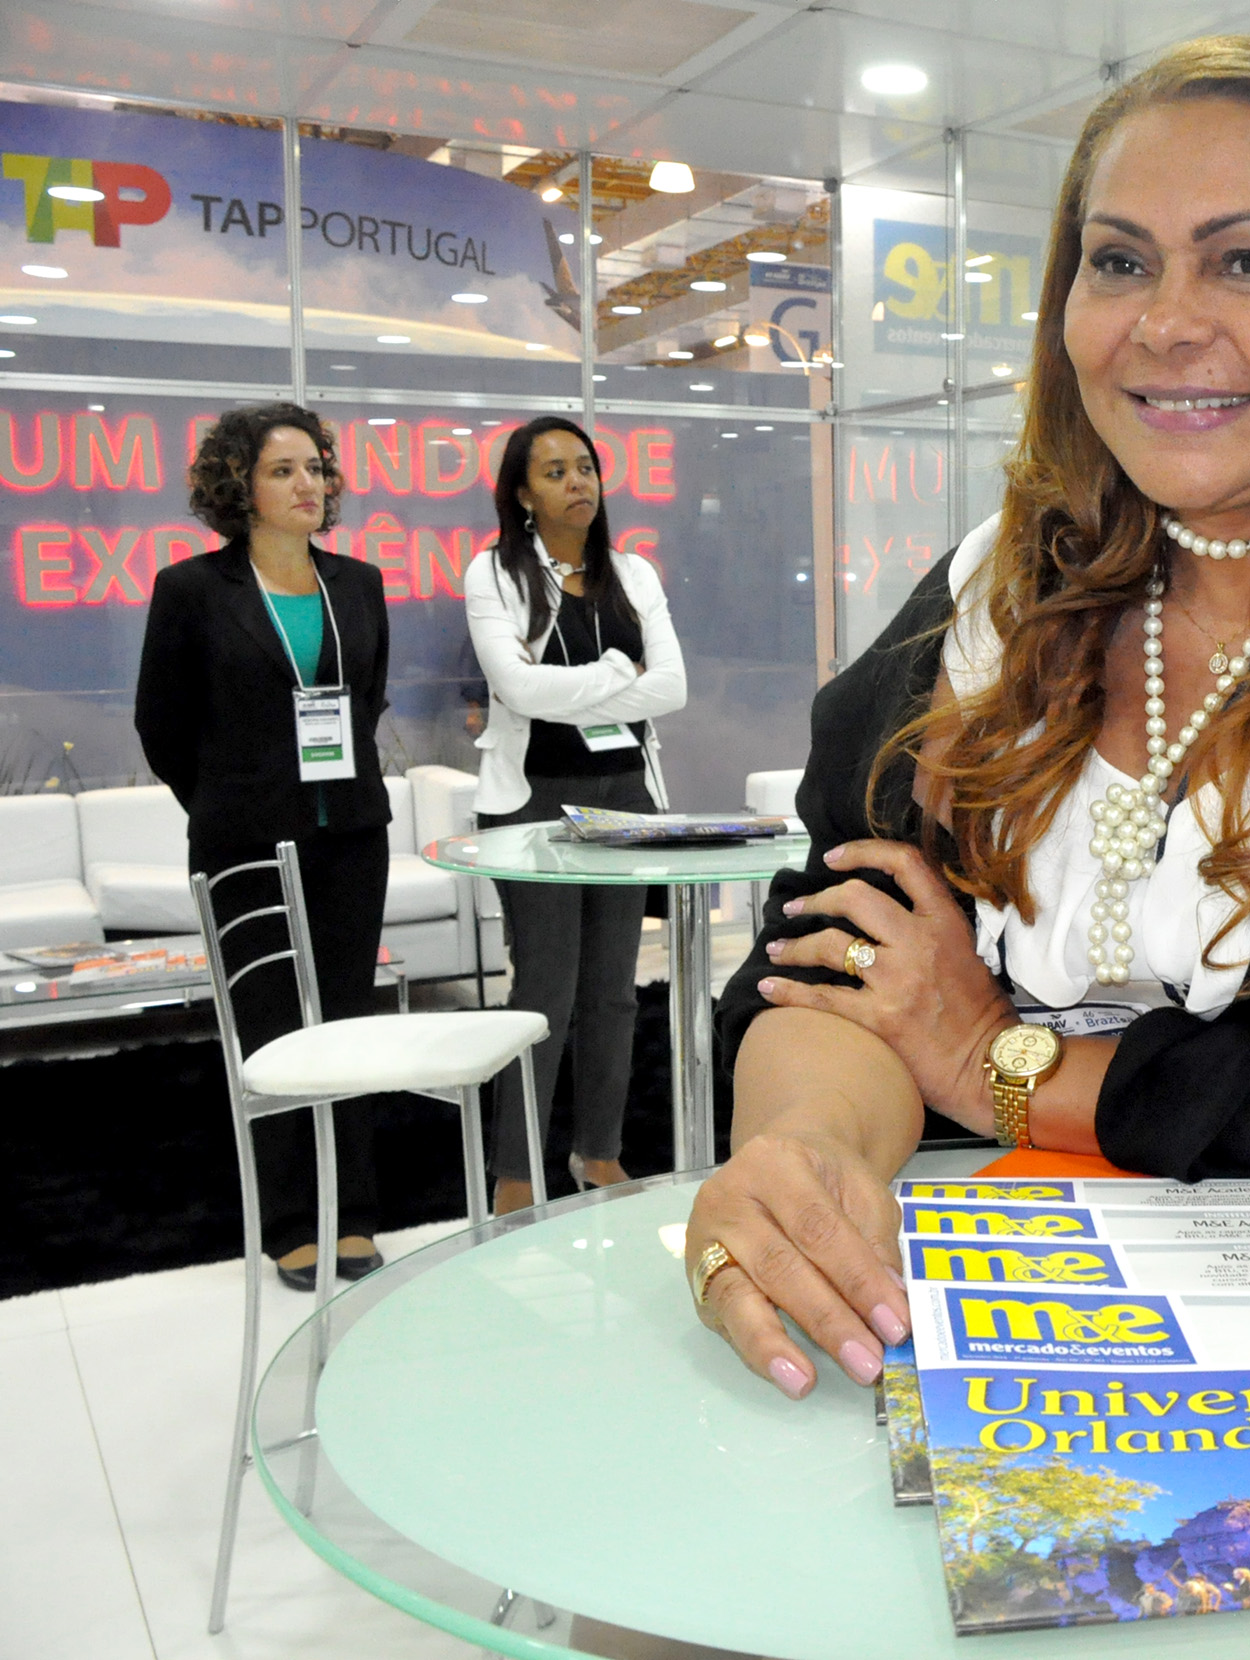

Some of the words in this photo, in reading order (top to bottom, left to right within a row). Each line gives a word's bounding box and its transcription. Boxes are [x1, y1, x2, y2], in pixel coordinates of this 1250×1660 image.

[2, 153, 172, 248] TAP
[190, 193, 286, 238] TAP
[300, 206, 496, 276] PORTUGAL
[768, 296, 820, 362] G
[0, 412, 163, 493] UM
[914, 1209, 1085, 1238] m&e
[1193, 1220, 1233, 1228] M&E
[922, 1246, 1110, 1283] m&e
[960, 1298, 1171, 1344] m&e
[968, 1341, 1175, 1357] mercado&eventos
